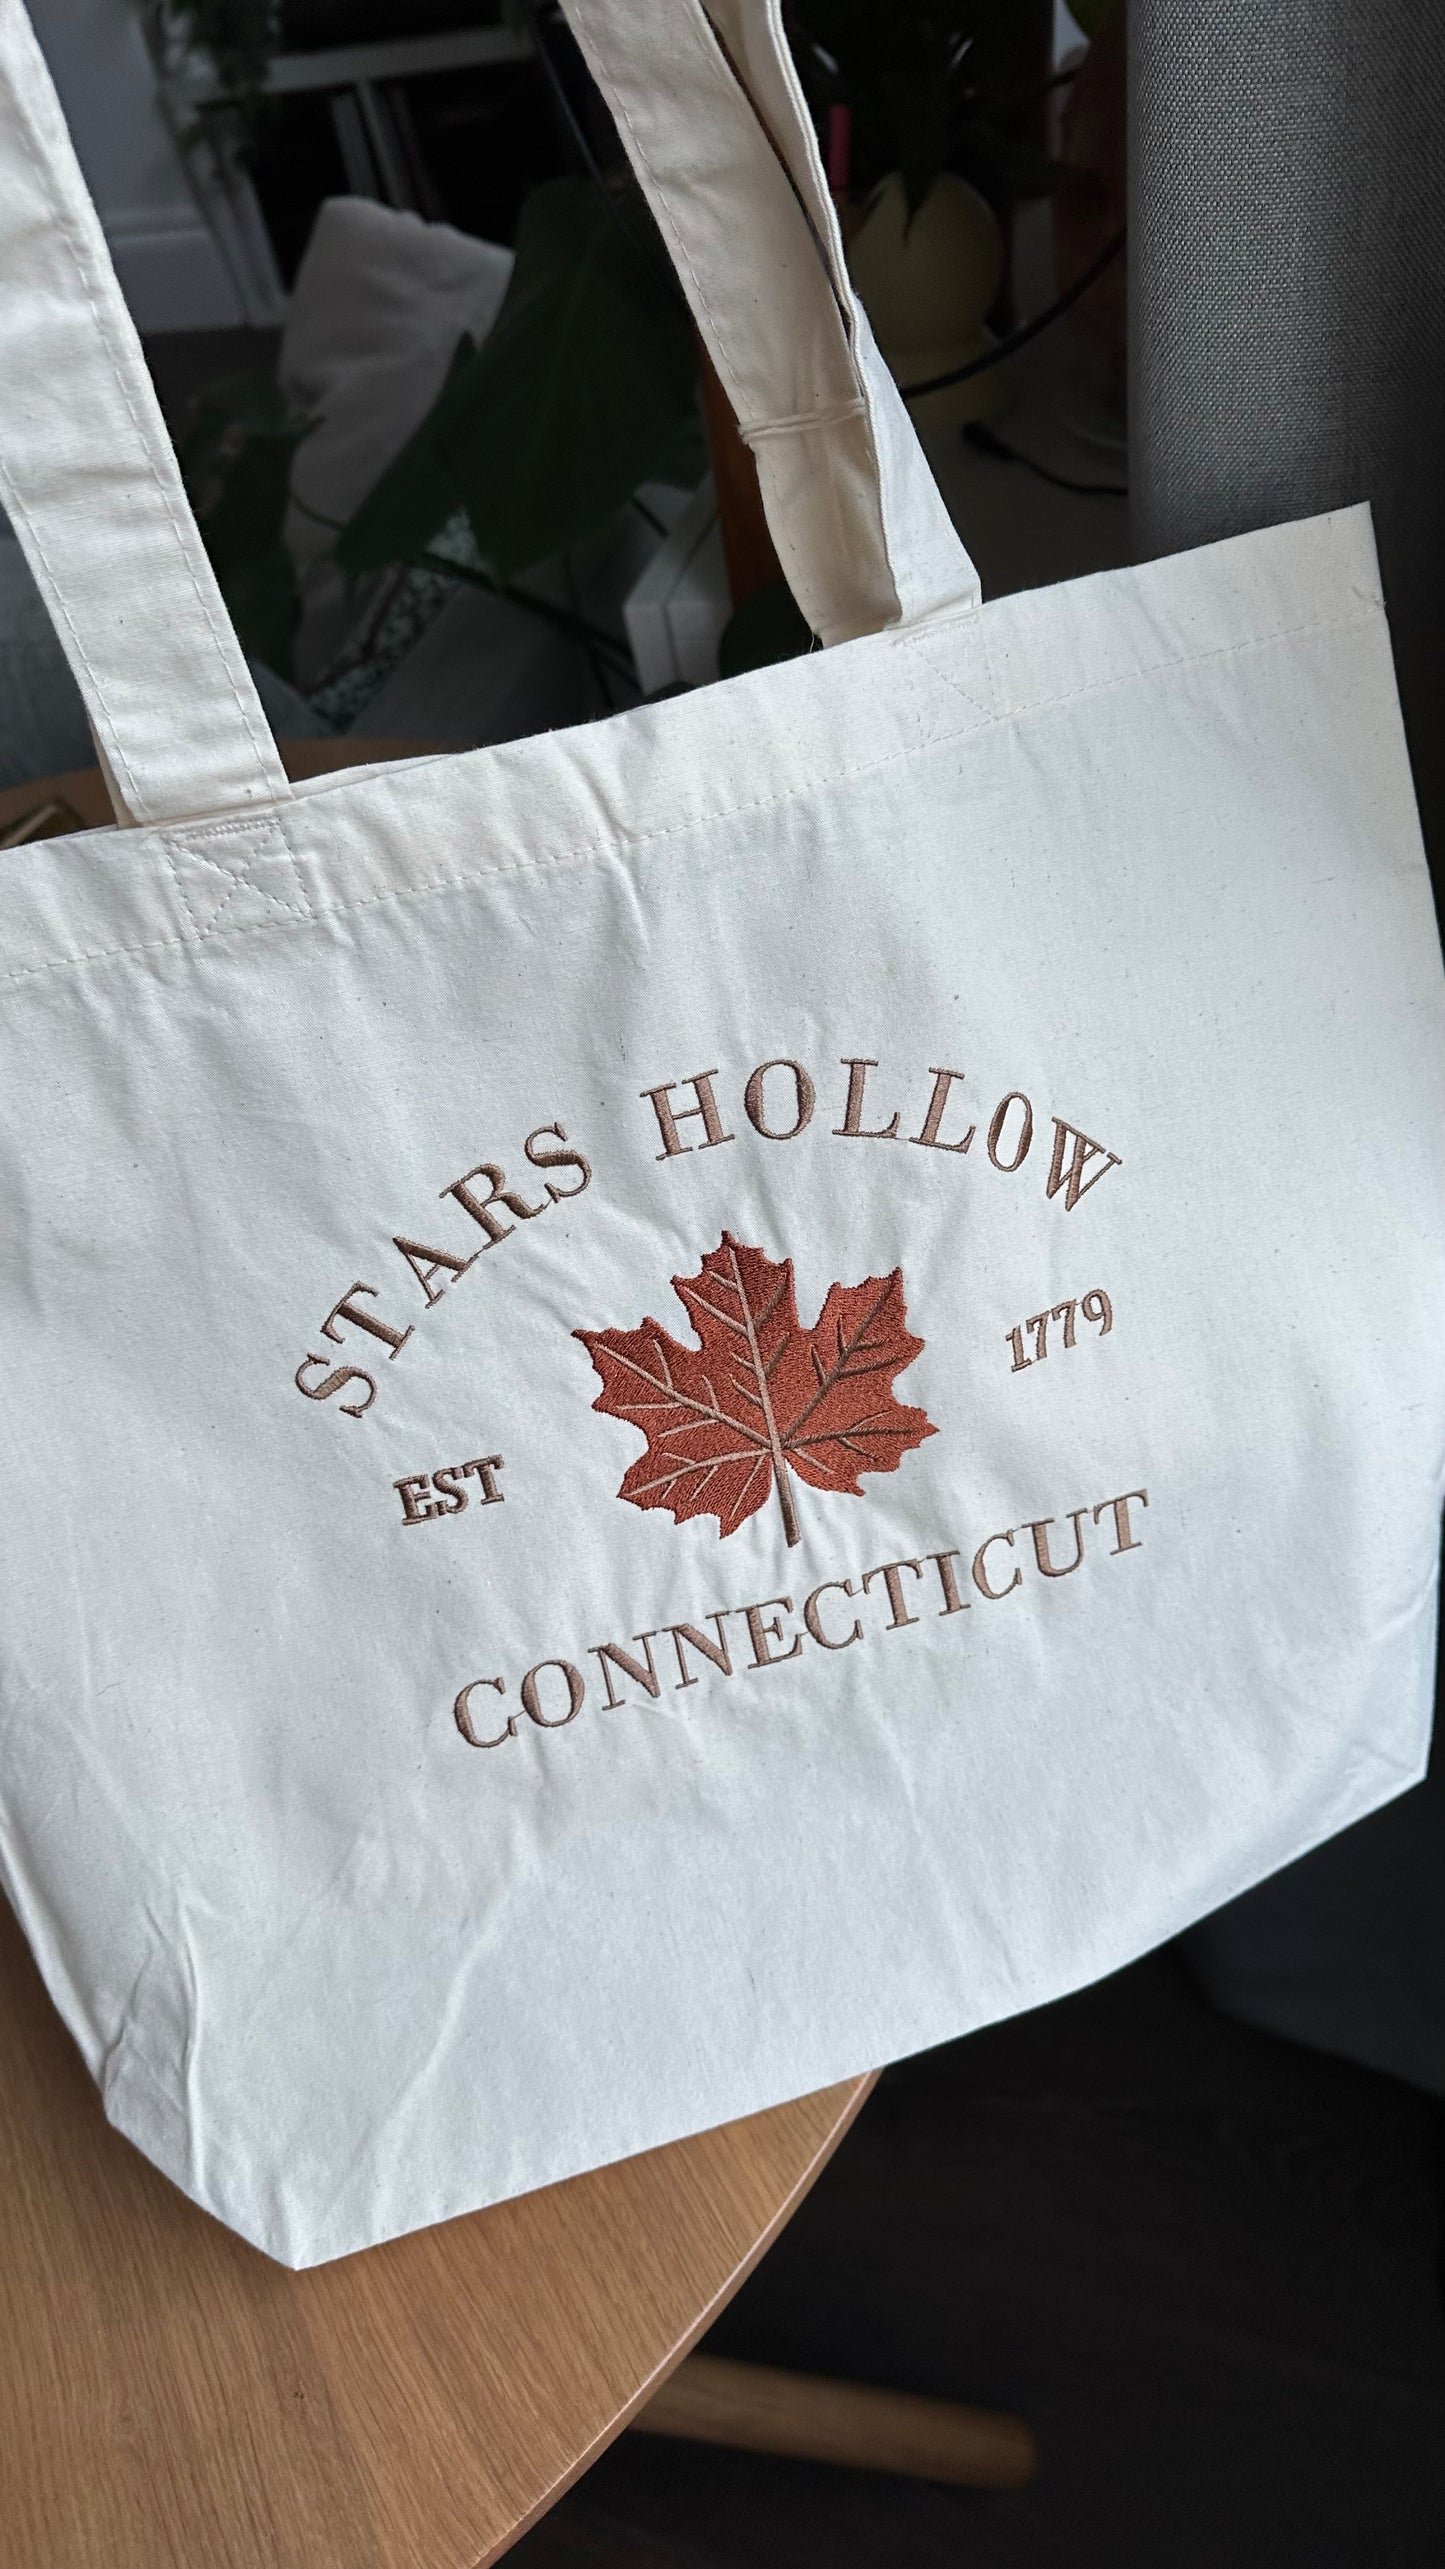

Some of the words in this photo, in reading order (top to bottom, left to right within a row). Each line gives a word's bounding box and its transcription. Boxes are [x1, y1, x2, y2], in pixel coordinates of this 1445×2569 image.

[295, 1122, 592, 1418] STARS
[640, 1058, 1122, 1211] HOLLOW
[393, 1454, 505, 1526] EST
[1005, 1289, 1114, 1373] 1779
[453, 1489, 1150, 1748] CONNECTICUT
